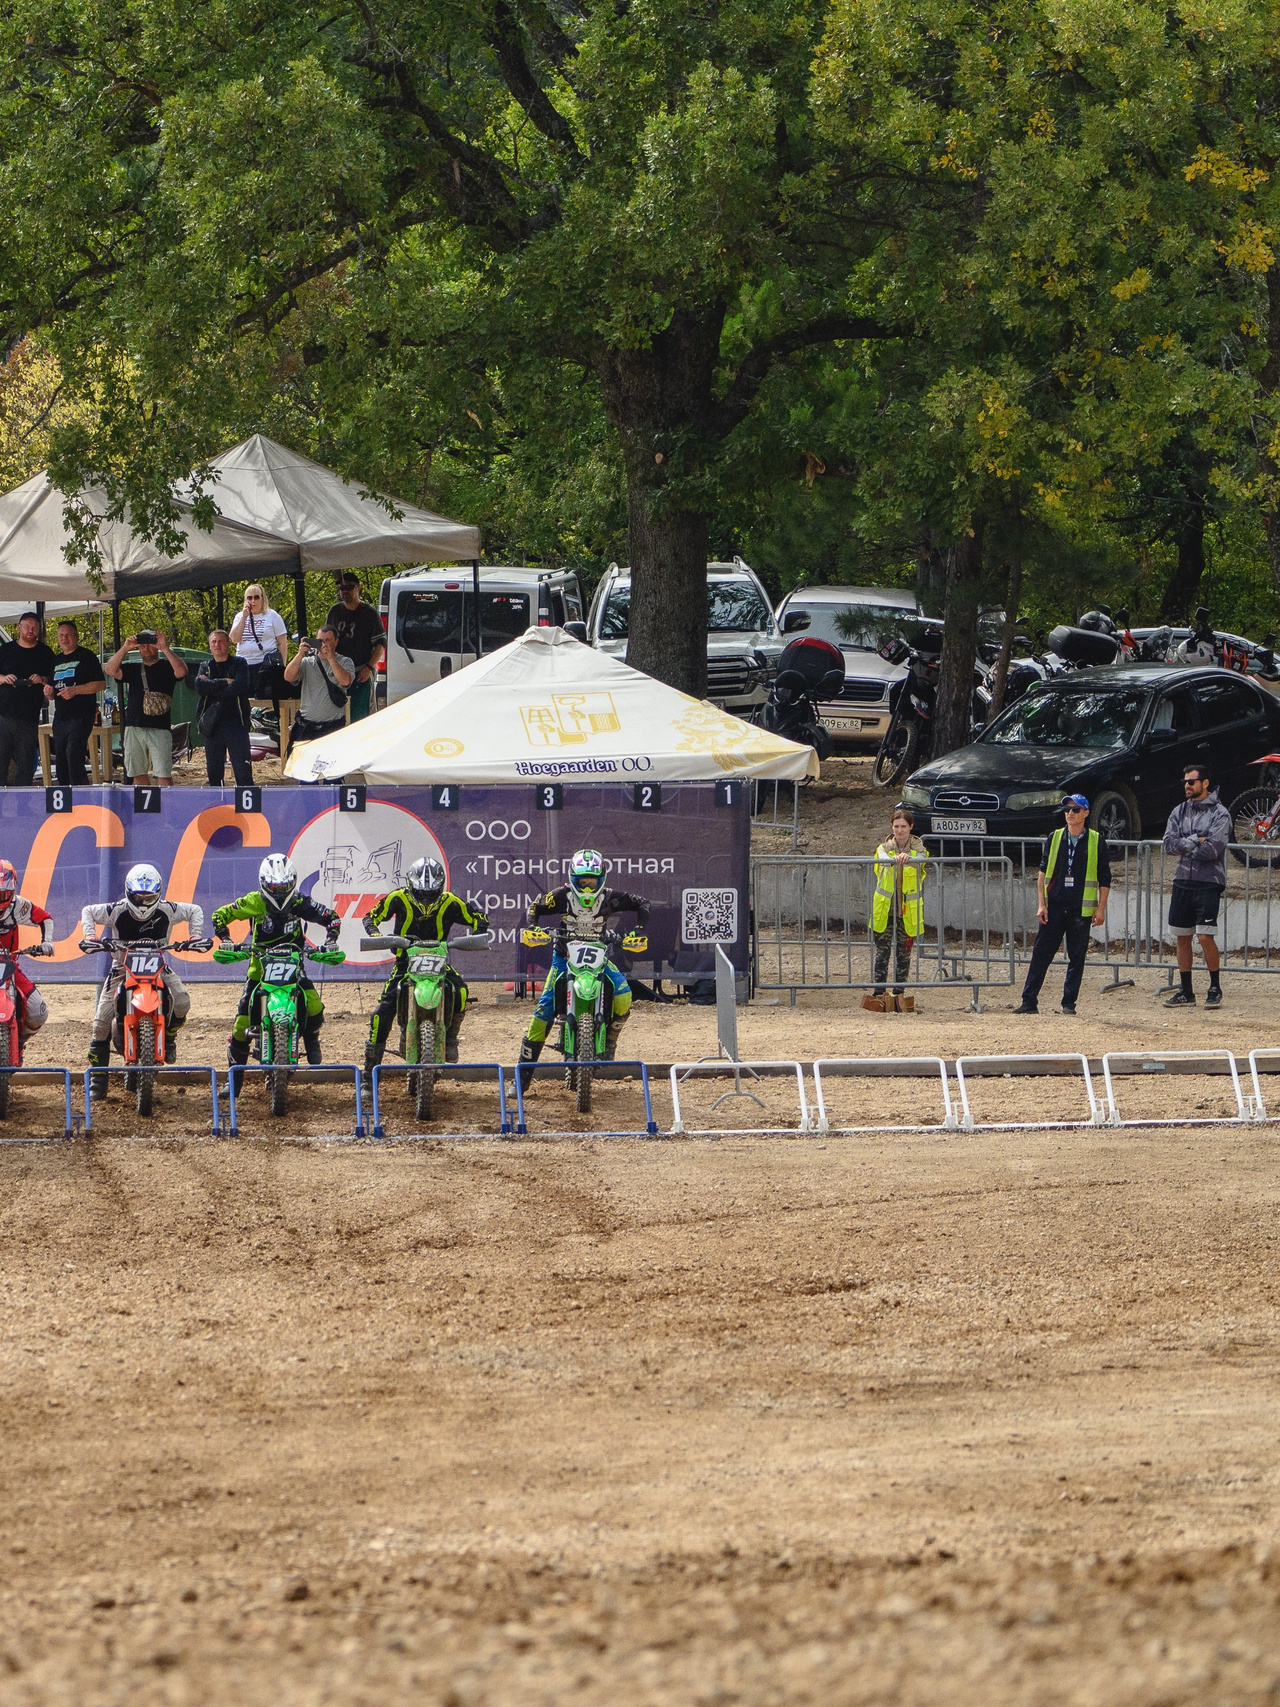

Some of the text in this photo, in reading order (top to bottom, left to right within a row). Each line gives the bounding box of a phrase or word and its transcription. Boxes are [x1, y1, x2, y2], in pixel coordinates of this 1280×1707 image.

[515, 758, 617, 777] Hoegaarden
[53, 789, 65, 810] 8
[141, 789, 152, 810] 7
[242, 789, 253, 810] 6
[346, 788, 357, 809] 5
[439, 788, 451, 808] 4
[543, 787, 554, 808] 3
[641, 787, 652, 807] 2
[724, 785, 732, 805] 1
[466, 820, 531, 840] ООО
[936, 821, 983, 832] А803РУ 82
[465, 855, 674, 880] «Трансптная
[131, 956, 159, 973] 114
[410, 956, 446, 973] 757
[576, 947, 598, 964] 15
[265, 963, 297, 981] 127
